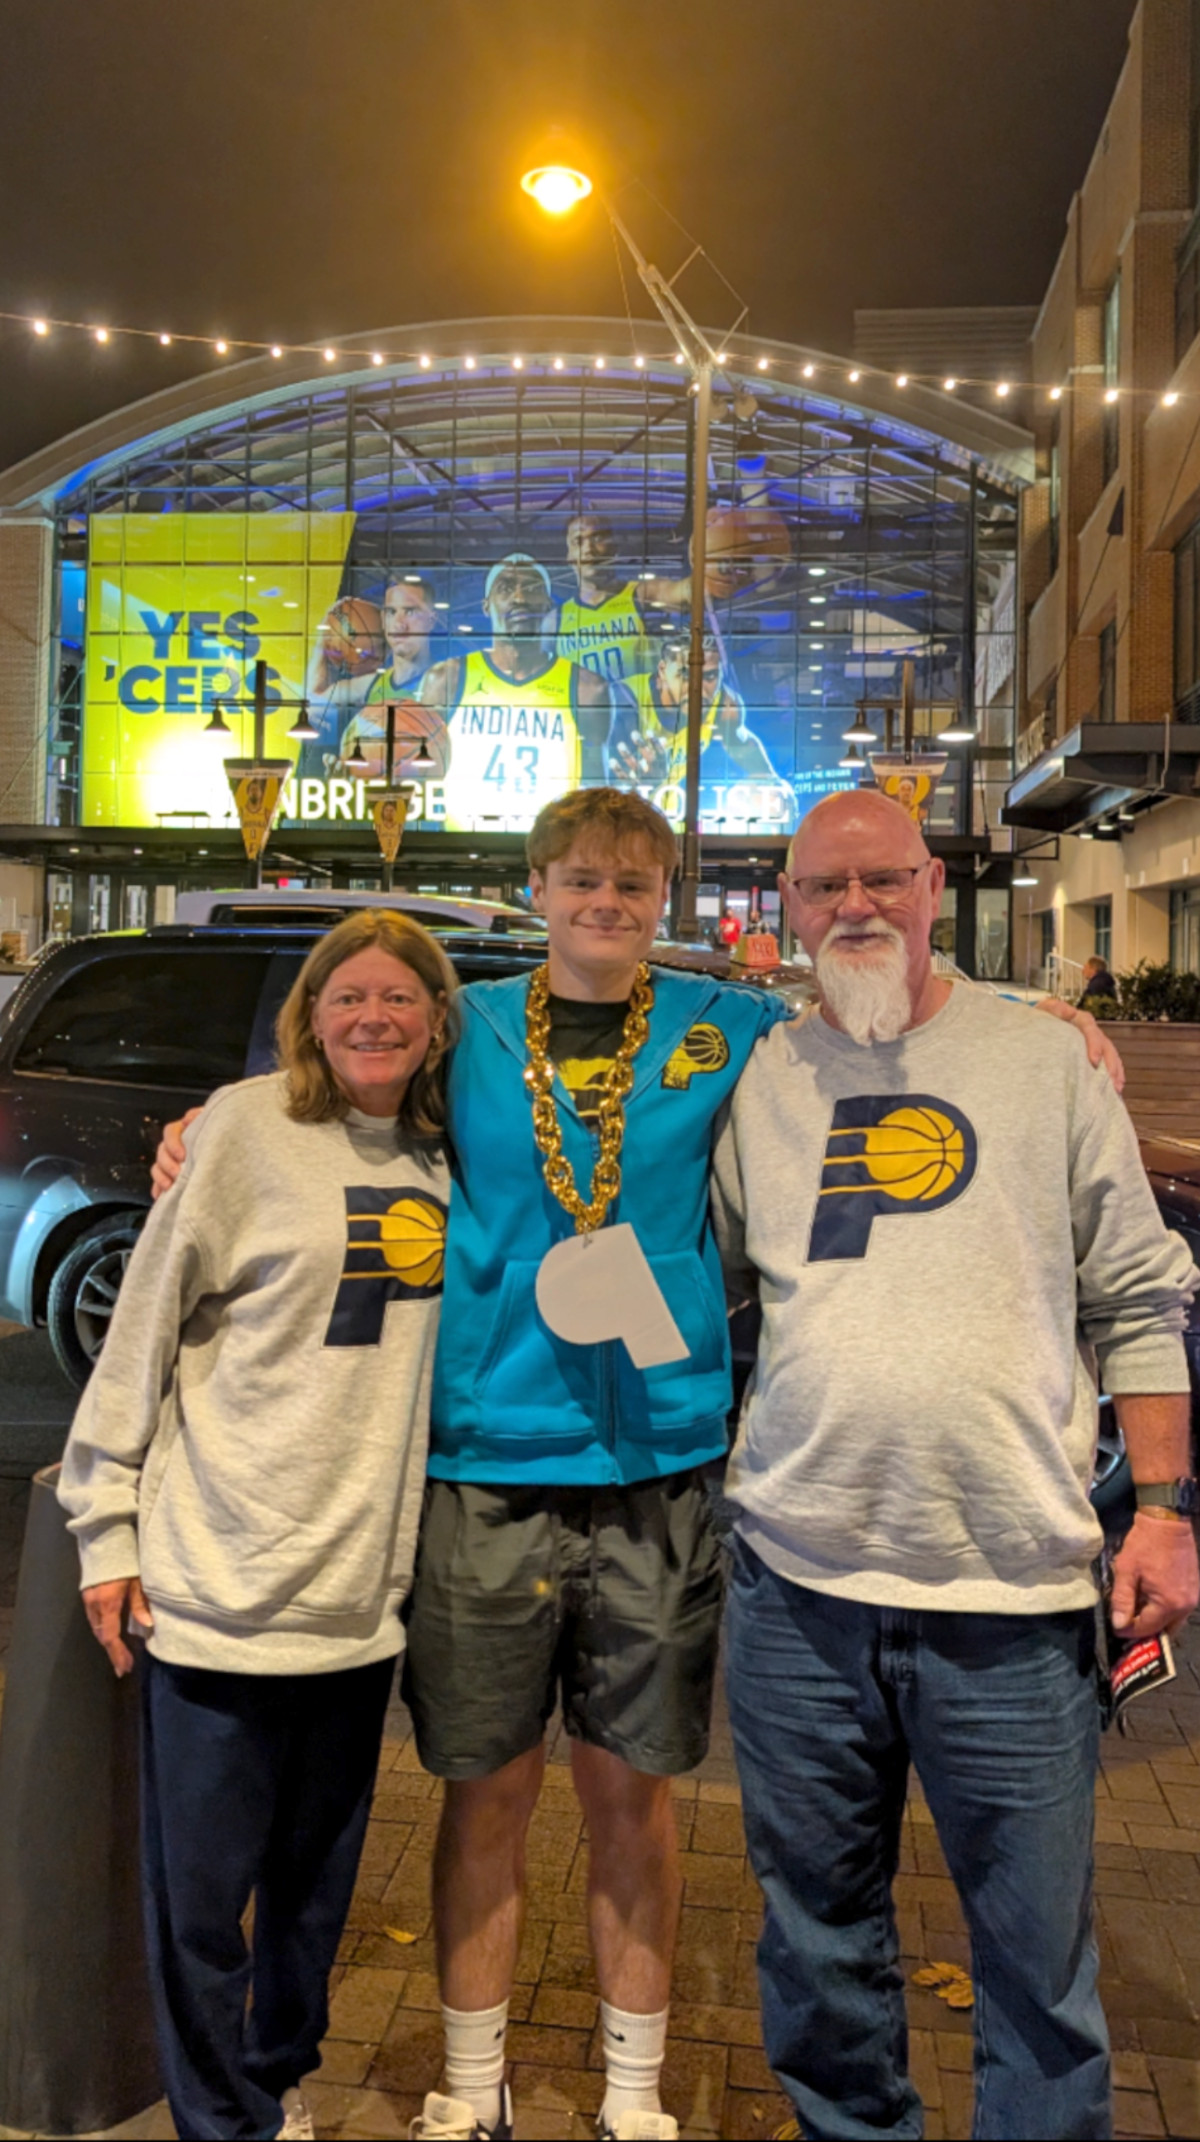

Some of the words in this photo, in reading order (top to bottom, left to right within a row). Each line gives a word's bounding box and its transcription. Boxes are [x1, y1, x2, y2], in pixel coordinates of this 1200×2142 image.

[138, 611, 261, 660] YES
[559, 615, 639, 656] INDIANA
[582, 646, 625, 682] 00
[460, 704, 565, 743] INDIANA
[482, 743, 540, 794] 43
